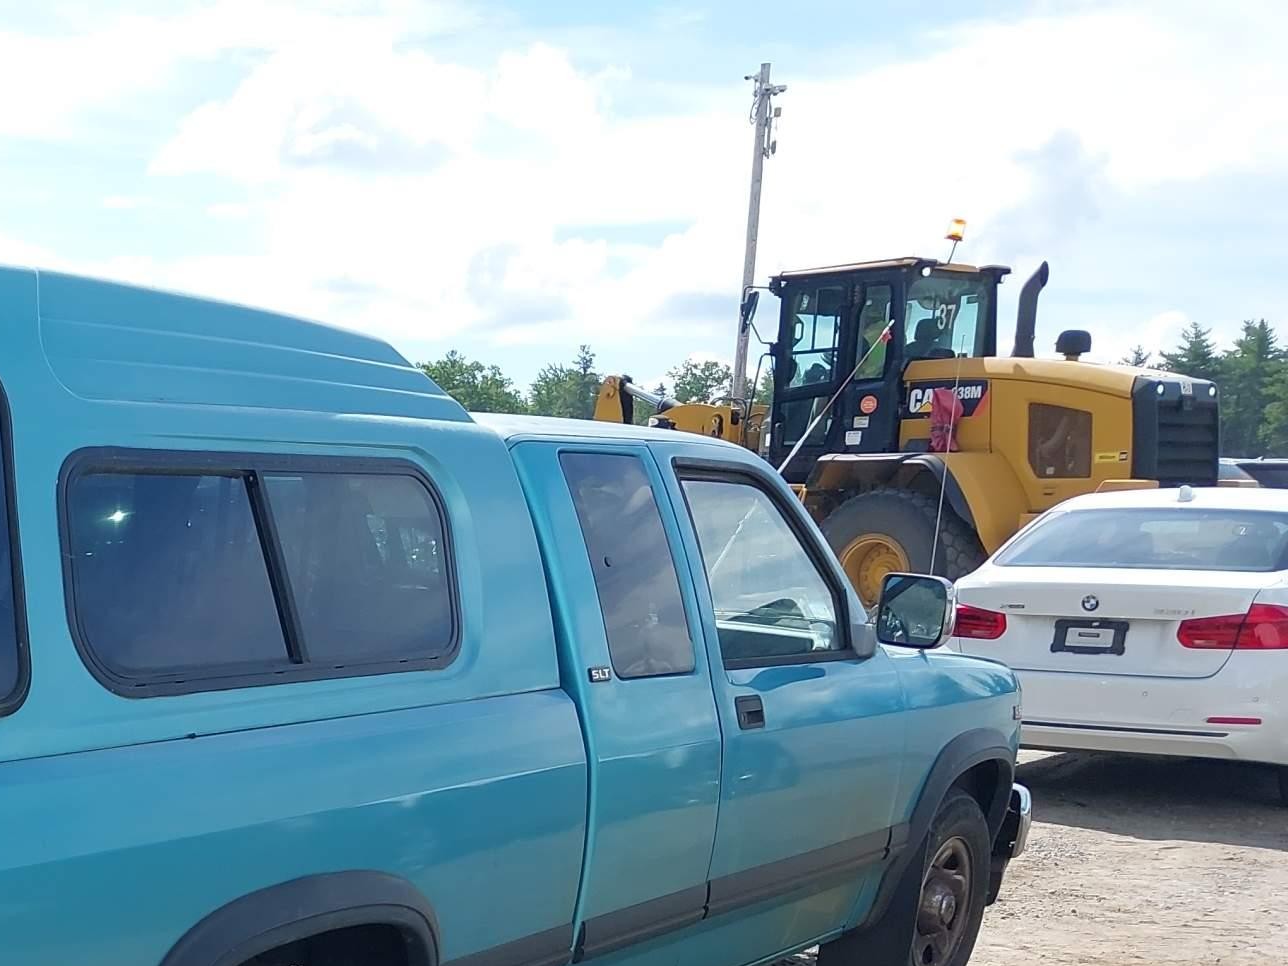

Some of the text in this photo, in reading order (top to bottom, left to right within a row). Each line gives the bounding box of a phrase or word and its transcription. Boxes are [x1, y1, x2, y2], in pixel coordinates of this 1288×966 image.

[937, 303, 957, 330] 37
[909, 387, 942, 413] CA
[592, 669, 610, 679] SLT
